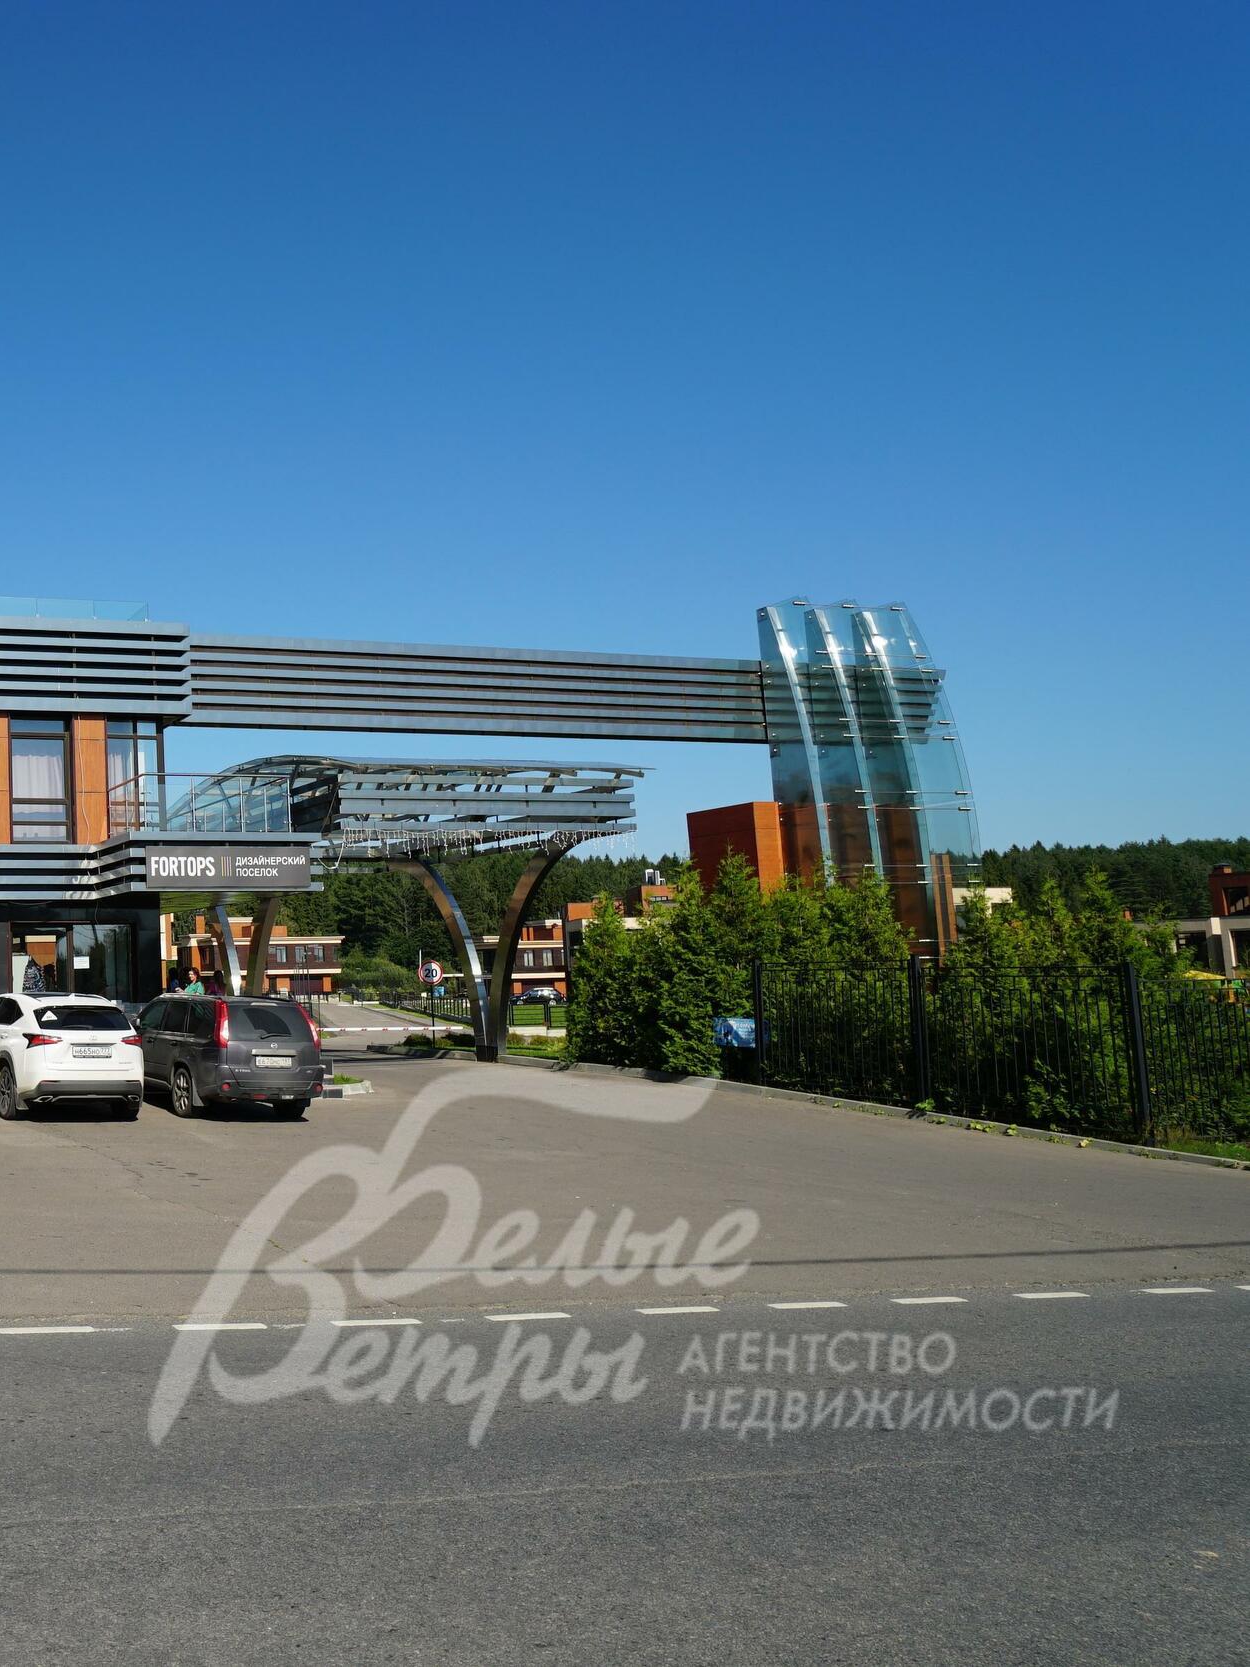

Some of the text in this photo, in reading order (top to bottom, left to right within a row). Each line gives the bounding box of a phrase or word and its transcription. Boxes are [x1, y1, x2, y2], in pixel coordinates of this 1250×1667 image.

[235, 855, 306, 866] ДИЗАЙНЕРСКИЙ
[151, 856, 216, 877] FORTOPS
[236, 867, 279, 877] ПОСЕЛОК
[425, 968, 438, 978] 20
